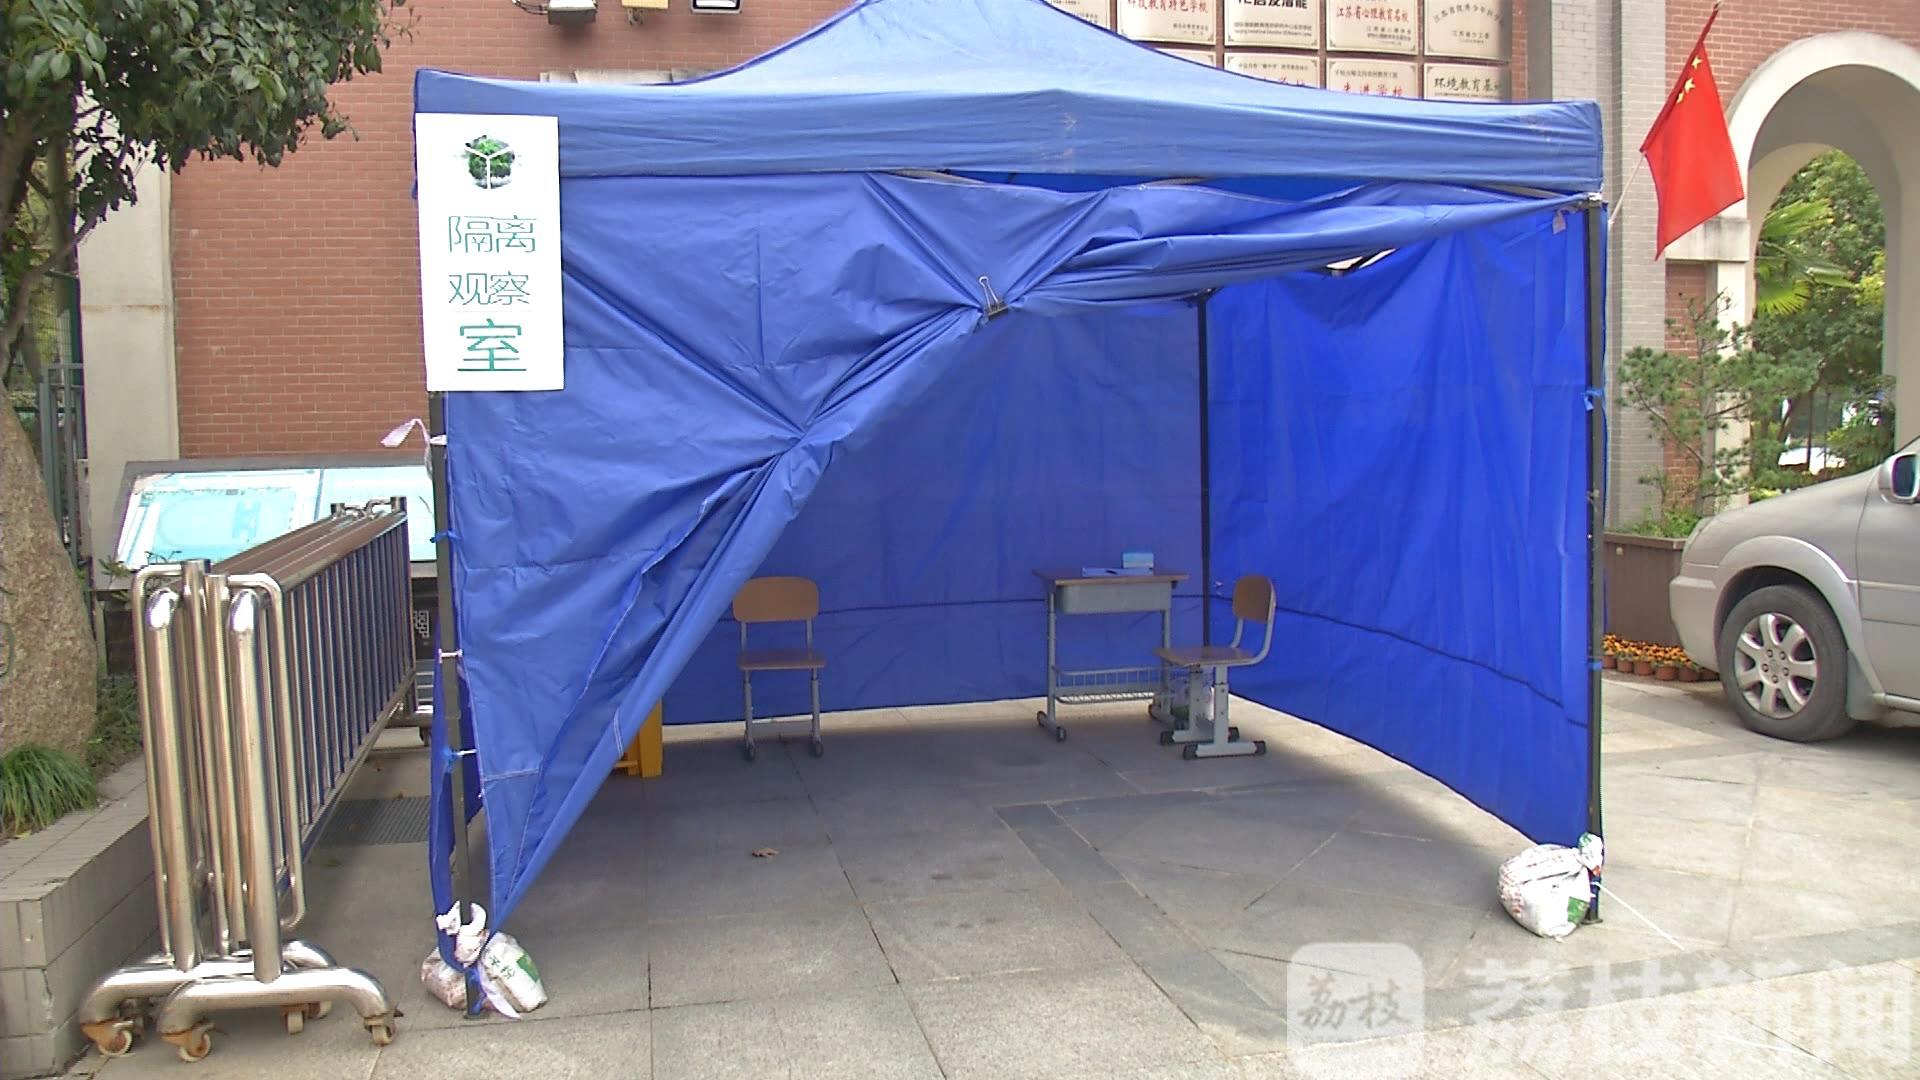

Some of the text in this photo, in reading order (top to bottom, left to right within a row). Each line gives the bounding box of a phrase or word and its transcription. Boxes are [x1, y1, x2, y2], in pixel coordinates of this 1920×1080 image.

[448, 214, 537, 254] 隔离
[448, 271, 531, 306] 观察
[457, 318, 527, 373] 室
